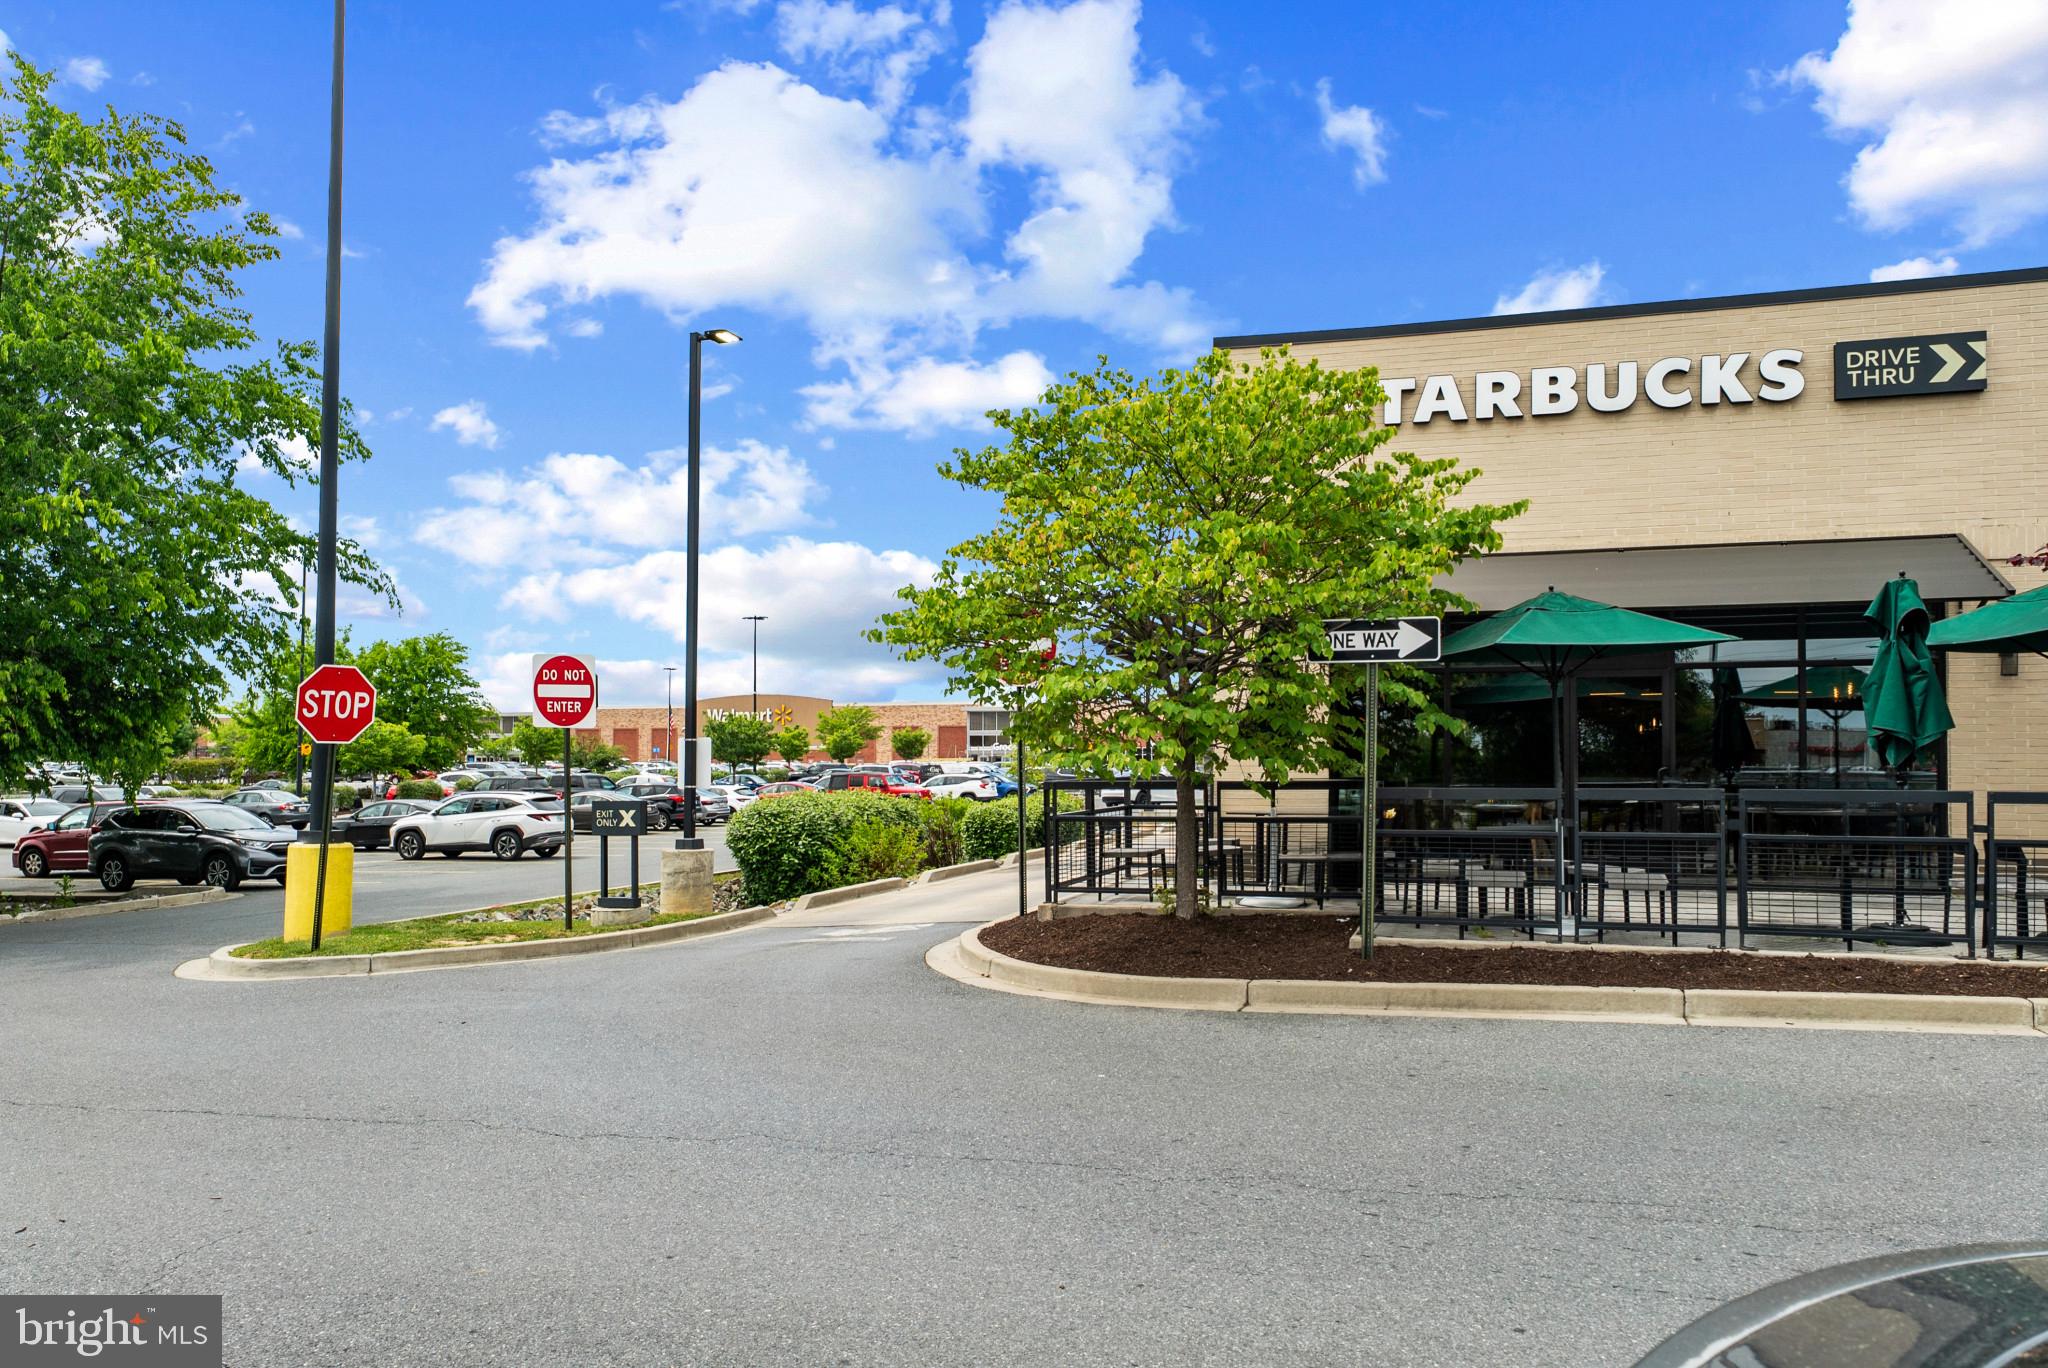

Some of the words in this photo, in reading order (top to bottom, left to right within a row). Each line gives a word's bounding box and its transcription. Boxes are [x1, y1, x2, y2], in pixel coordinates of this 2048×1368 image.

[1846, 346, 1921, 369] DRIVE
[1847, 366, 1915, 387] THRU
[1345, 348, 1806, 426] TARBUCKS
[1362, 631, 1399, 648] WAY
[542, 669, 558, 681] DO
[564, 669, 586, 681] NOT
[302, 689, 370, 719] STOP
[546, 701, 582, 713] ENTER
[596, 810, 614, 818] EXIT
[596, 819, 618, 827] ONLY
